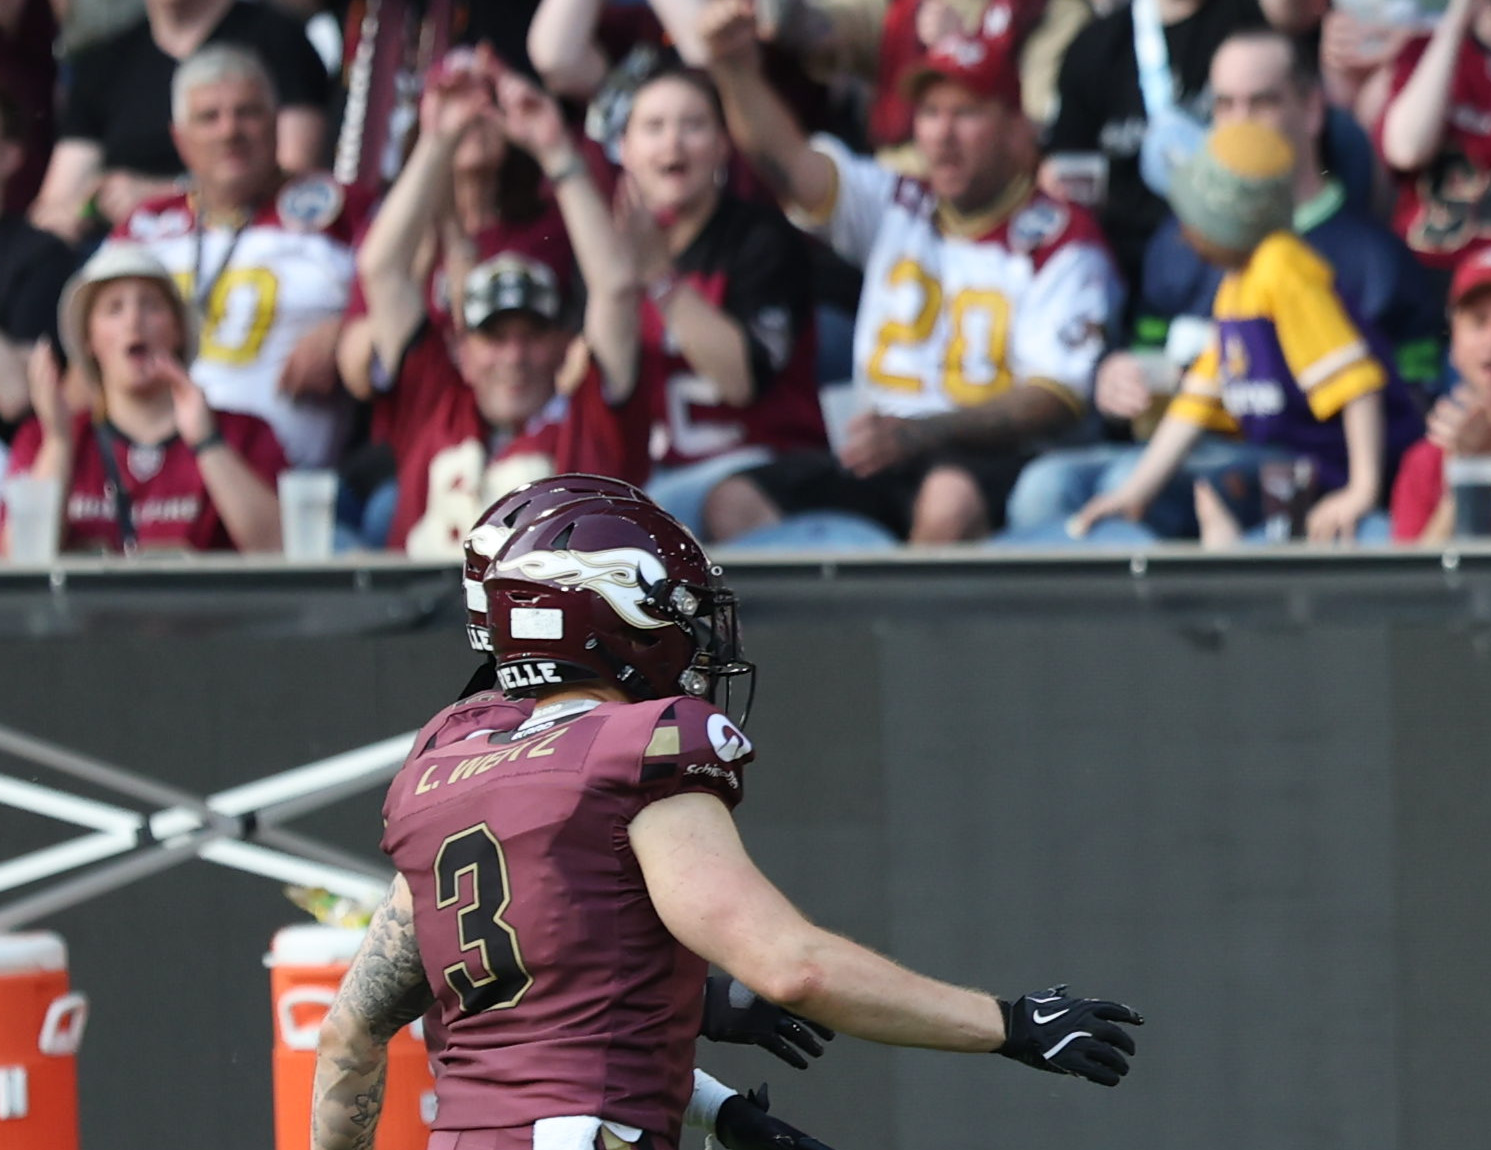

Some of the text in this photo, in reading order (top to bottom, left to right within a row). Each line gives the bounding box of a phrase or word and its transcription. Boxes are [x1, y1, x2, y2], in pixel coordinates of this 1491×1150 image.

[867, 260, 1012, 407] 20
[415, 764, 440, 795] L.
[434, 822, 534, 1013] 3
